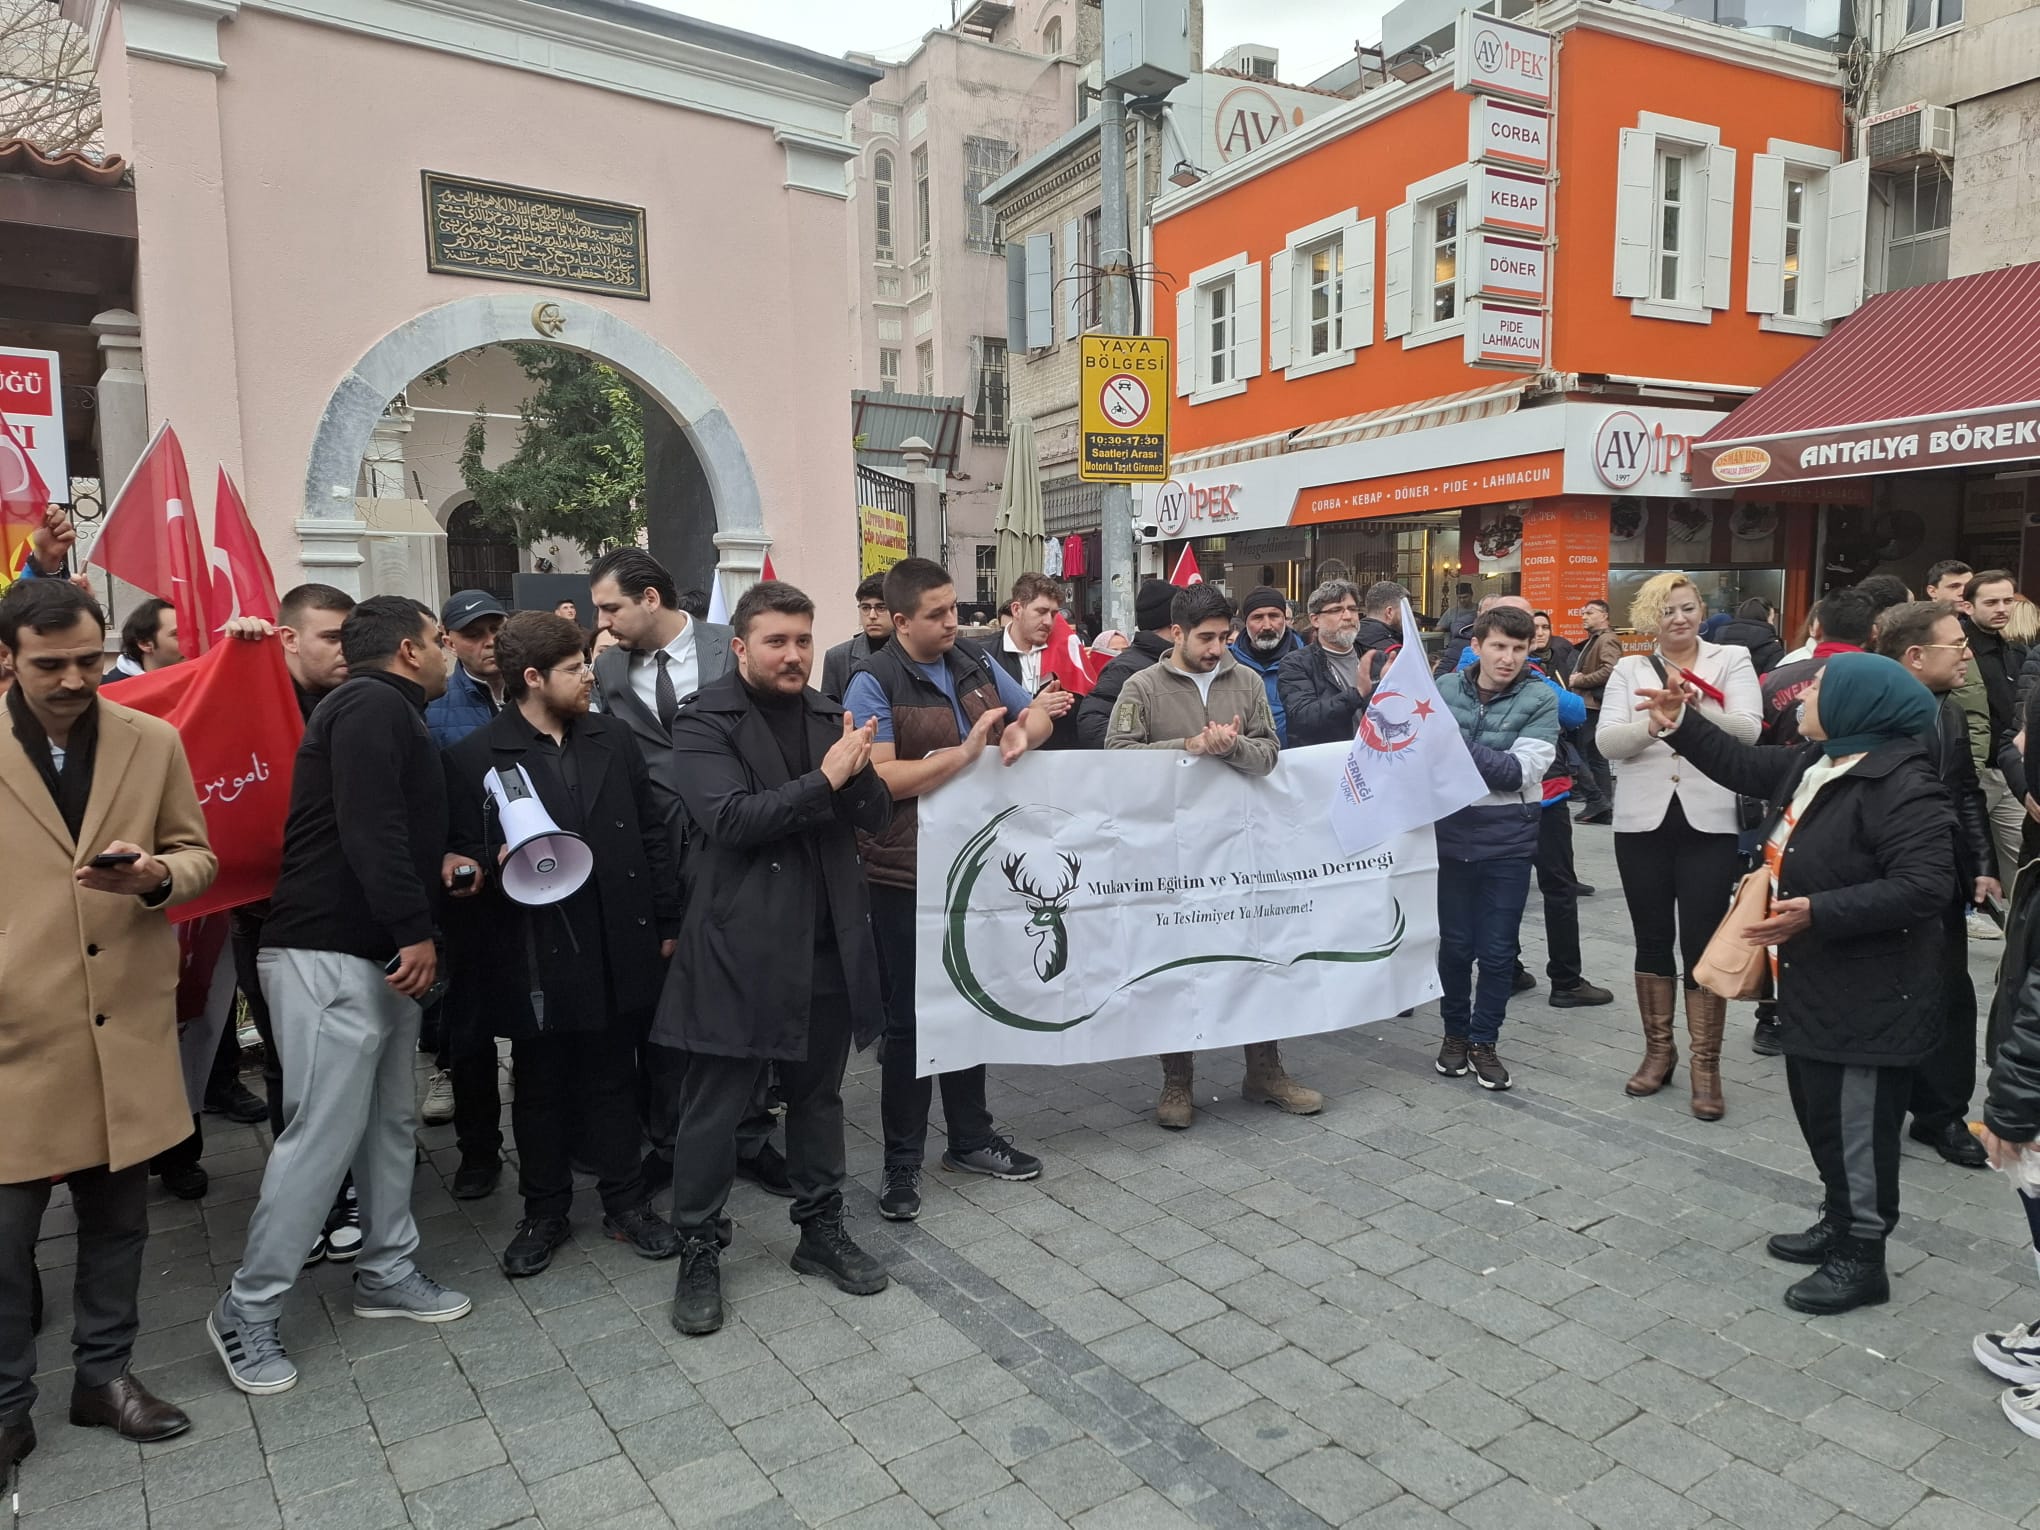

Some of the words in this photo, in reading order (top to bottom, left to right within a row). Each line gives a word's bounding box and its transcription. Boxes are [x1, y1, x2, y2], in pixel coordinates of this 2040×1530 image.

[1477, 40, 1500, 65] AY
[1491, 122, 1541, 145] ÇORBA
[1491, 190, 1538, 211] KEBAP
[1490, 256, 1536, 277] DÖNER
[1099, 339, 1150, 354] YAYA
[1482, 333, 1540, 350] LAHMACUN
[1086, 354, 1164, 370] BÖLGESİ
[0, 370, 42, 394] ĞÜ
[1090, 435, 1159, 447] 10:30-17:30
[1602, 430, 1648, 469] AY
[1800, 434, 1919, 469] ANTALYA
[1929, 420, 2040, 454] BÖREK
[1092, 448, 1129, 459] Saatleri
[1130, 449, 1157, 459] Arası
[1085, 461, 1113, 472] Motorlu
[1114, 462, 1132, 474] Taşıt
[1133, 462, 1163, 473] Giremez
[1615, 473, 1631, 482] 1997
[1311, 498, 1341, 513] ÇORBA
[1352, 491, 1383, 506] KEBAP
[1394, 485, 1430, 500] DÖNER
[1482, 467, 1551, 488] LAHMACUN
[1159, 492, 1183, 522] AY
[1525, 556, 1556, 567] ÇORBA
[1569, 555, 1598, 566] ÇORBA
[1088, 877, 1153, 896] Mukavim
[1157, 874, 1205, 895] Eğitim
[1209, 875, 1226, 887] ve
[1230, 867, 1318, 885] Yardımlaşma
[1321, 851, 1394, 877] Derneği
[1156, 912, 1169, 927] Ya
[1173, 909, 1235, 925] Teslimiyet
[1238, 905, 1251, 920] Ya
[1253, 900, 1314, 919] Mukavemet!
